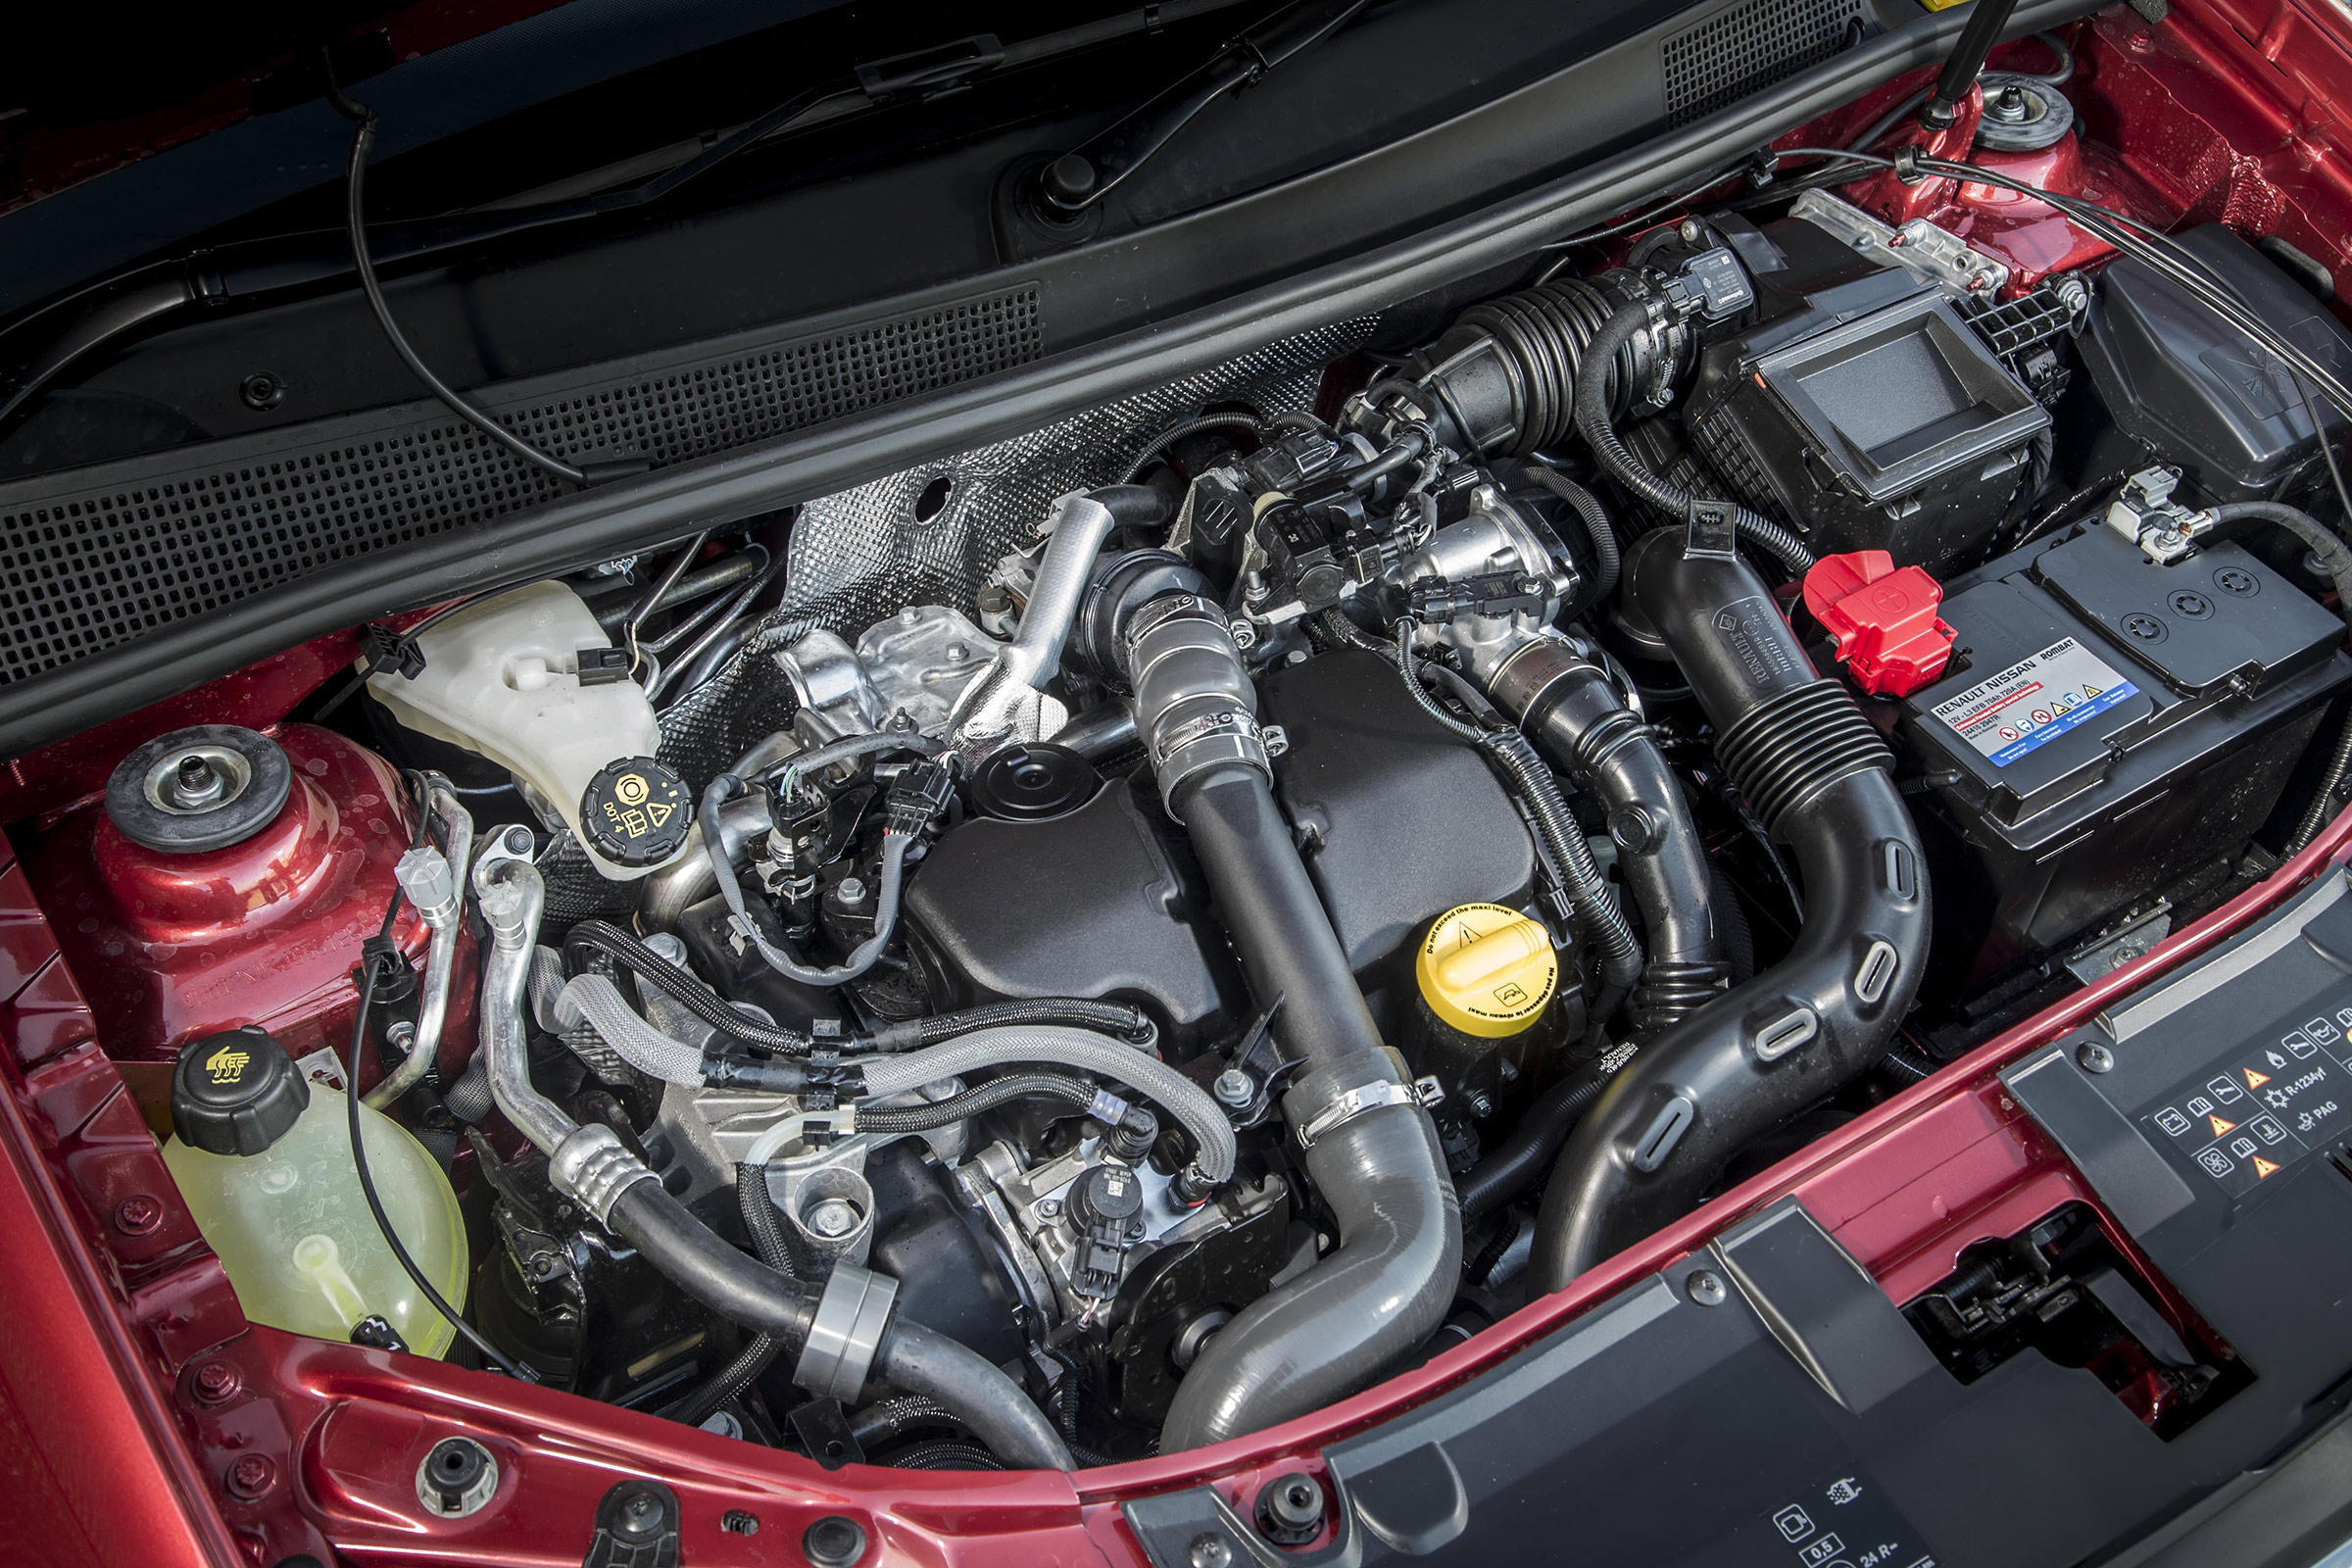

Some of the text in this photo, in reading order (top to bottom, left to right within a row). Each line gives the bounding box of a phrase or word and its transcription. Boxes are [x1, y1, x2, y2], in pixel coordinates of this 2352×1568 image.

[1730, 631, 1770, 684] RENAULT
[2039, 639, 2074, 661] ROMBAT
[1936, 661, 2037, 716] RENAULT NISSAN
[1948, 714, 1962, 724] 12V
[1964, 709, 1973, 717] L3
[1971, 702, 1986, 713] EFB
[1985, 694, 2001, 706] 70Ah
[2000, 686, 2017, 697] 720A
[2016, 679, 2031, 690] (EN)
[603, 802, 621, 822] DOT
[1455, 906, 1469, 914] the
[1493, 906, 1512, 916] level
[1436, 911, 1456, 931] exceed
[1430, 930, 1439, 943] not
[1427, 943, 1434, 955] Do
[1548, 966, 1554, 976] Ne
[1467, 1006, 1487, 1016] maxi
[2284, 1066, 2327, 1096] R-1234yf
[2313, 1101, 2338, 1119] PAG
[1810, 1541, 1833, 1560] 0,5
[1860, 1551, 1879, 1568] 24
